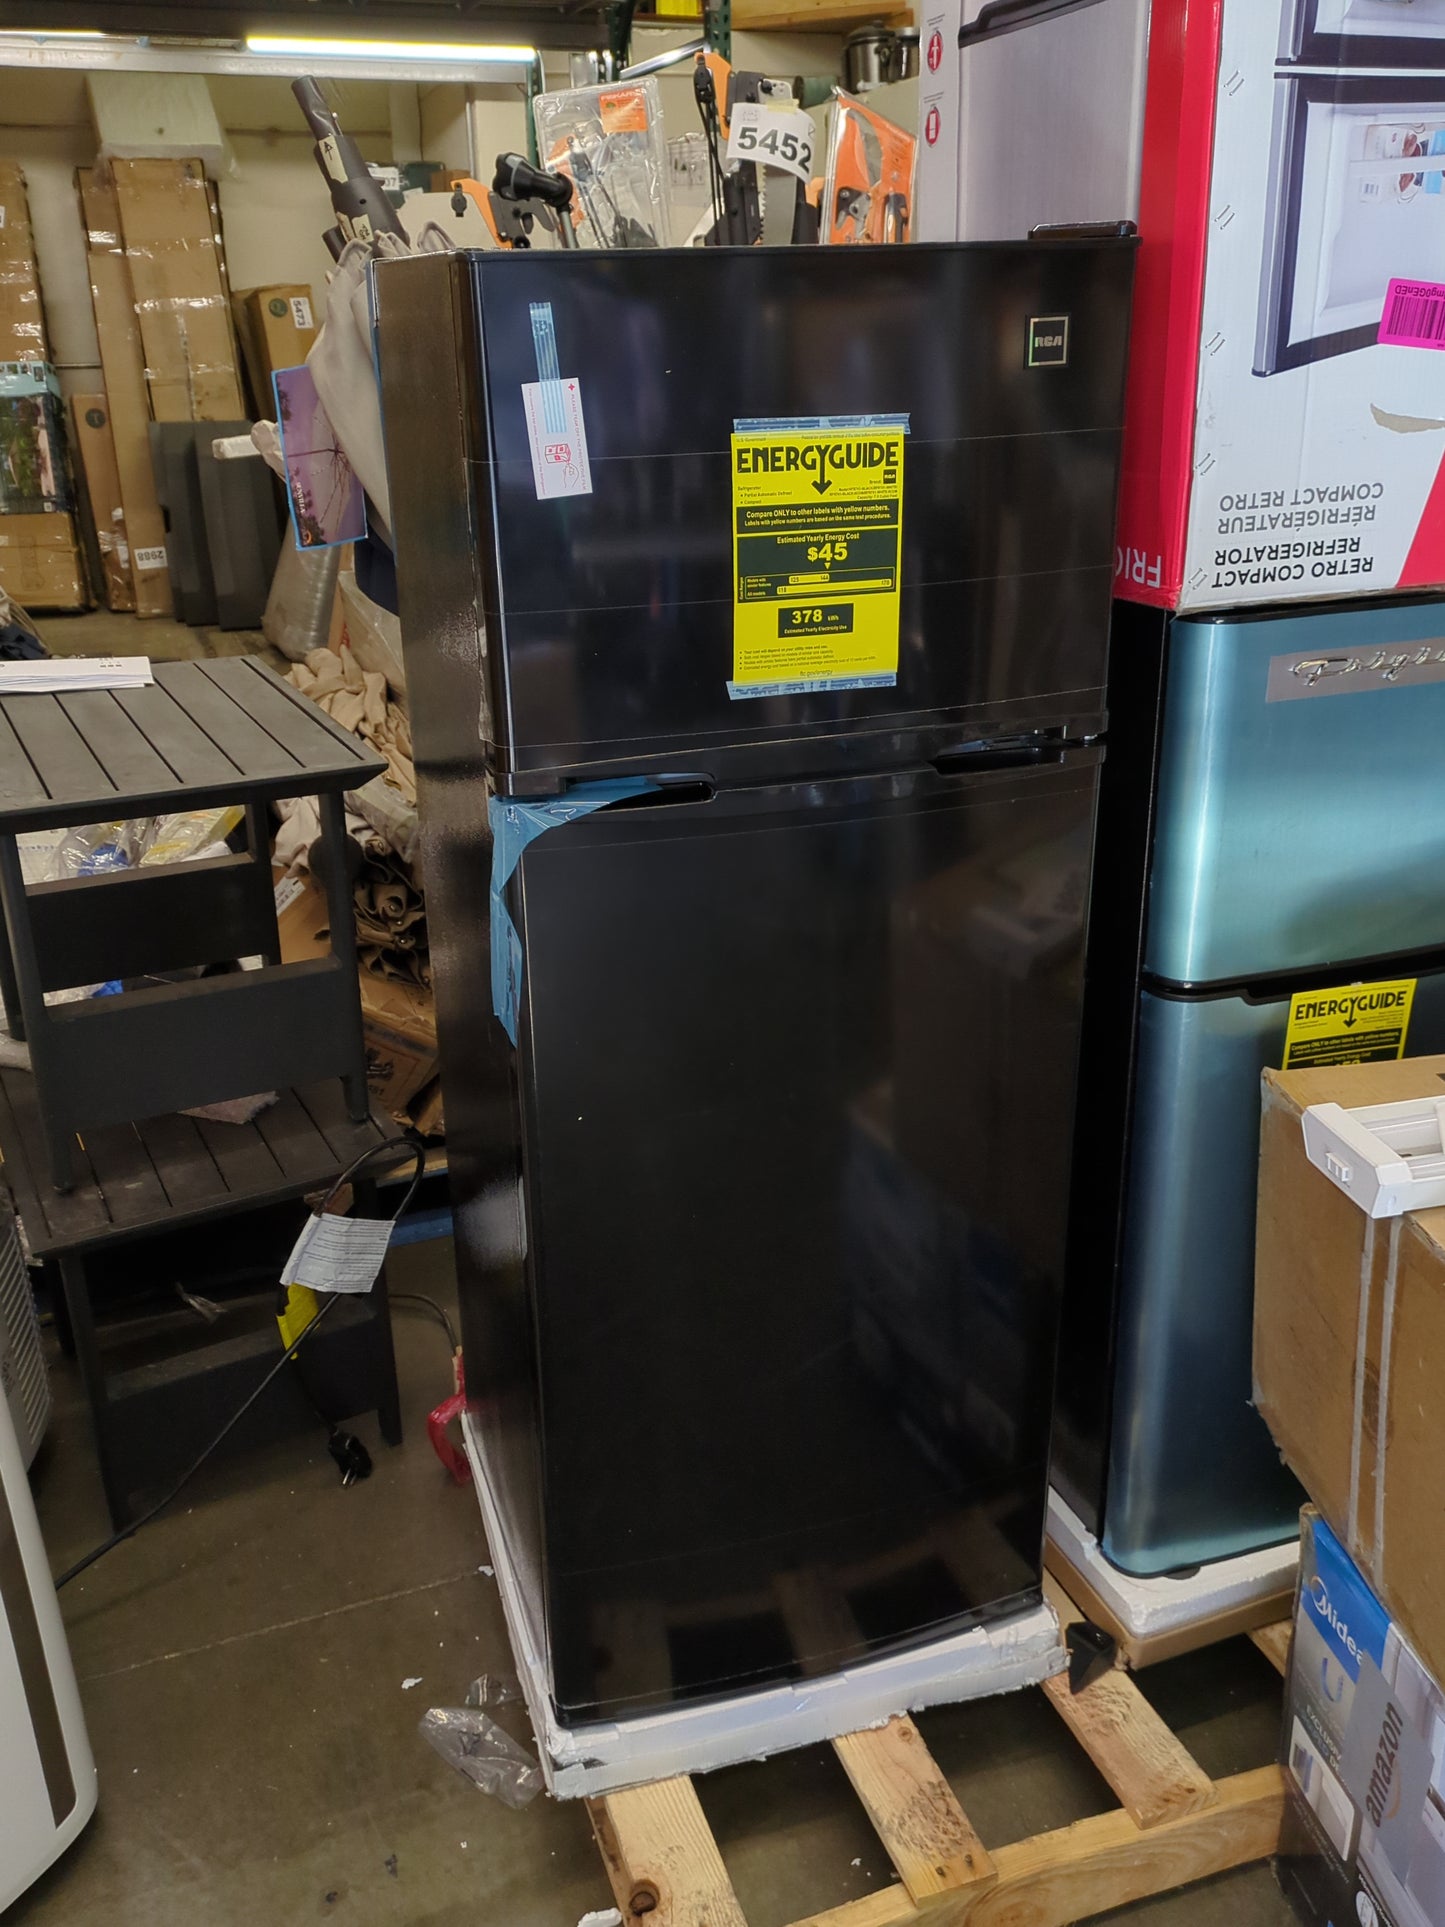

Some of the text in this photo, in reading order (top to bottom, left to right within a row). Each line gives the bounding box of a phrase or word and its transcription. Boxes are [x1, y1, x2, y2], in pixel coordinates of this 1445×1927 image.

[737, 127, 812, 174] 5452
[1034, 336, 1062, 348] RCA
[736, 442, 899, 474] ENERGYGUIDE
[746, 511, 773, 519] Compare
[813, 506, 830, 514] labels
[844, 505, 862, 514] yellow
[863, 504, 890, 512] numbers.
[1220, 482, 1384, 512] COMPACT RETRO
[1218, 505, 1376, 534] RÉFRIGÉRATEUR
[806, 534, 824, 543] Yearly
[825, 533, 845, 542] Energy
[808, 542, 848, 562] $45
[1214, 537, 1361, 566] REFRIGERATOR
[1212, 556, 1374, 588] RETRO COMPACT
[792, 609, 822, 624] 378
[1295, 991, 1408, 1020] ENERGYGUIDE
[1366, 1702, 1403, 1828] amazon
